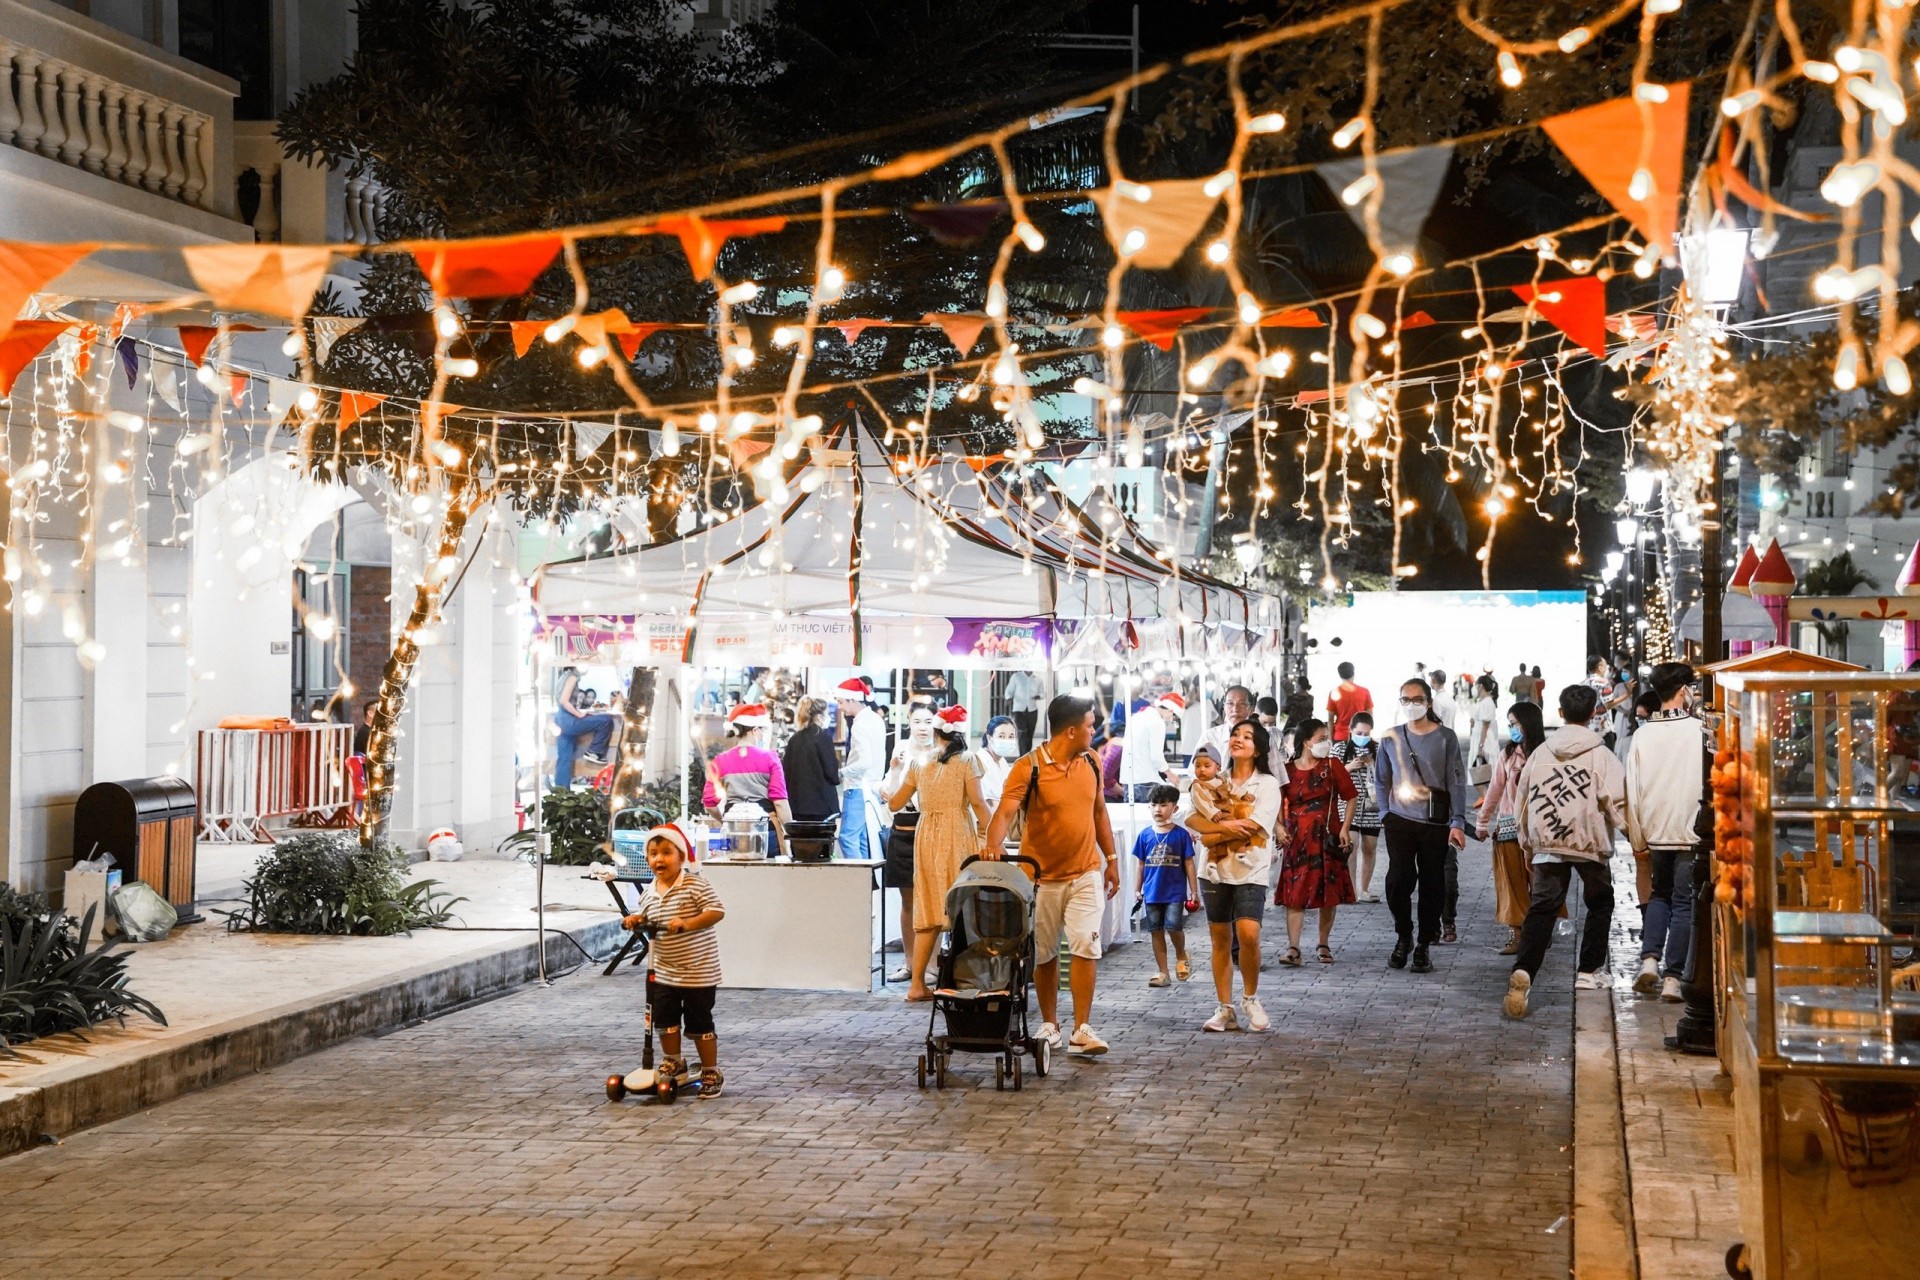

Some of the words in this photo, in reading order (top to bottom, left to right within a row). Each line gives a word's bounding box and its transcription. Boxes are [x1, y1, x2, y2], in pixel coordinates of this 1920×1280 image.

[822, 621, 846, 635] VIỆT
[848, 624, 872, 633] NM
[983, 623, 1035, 638] MARINA
[974, 631, 1036, 654] XMAS
[1541, 767, 1576, 807] THE
